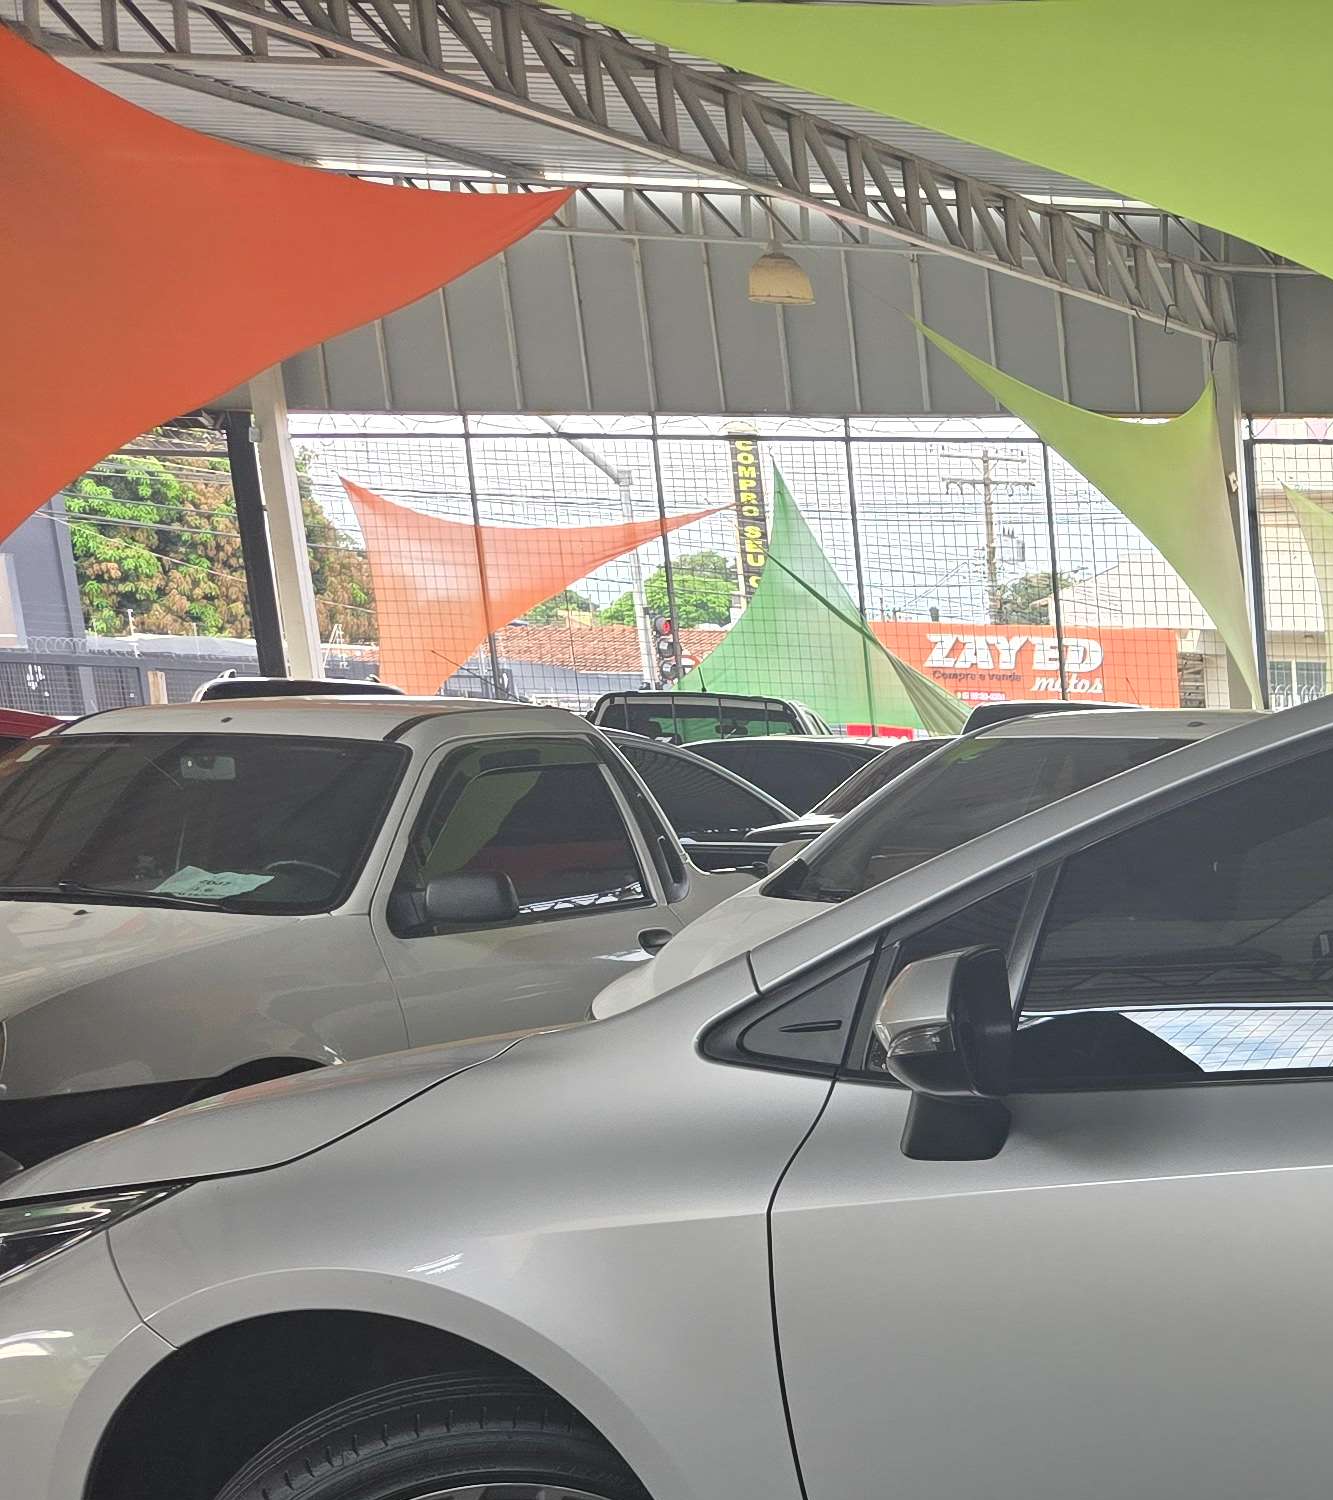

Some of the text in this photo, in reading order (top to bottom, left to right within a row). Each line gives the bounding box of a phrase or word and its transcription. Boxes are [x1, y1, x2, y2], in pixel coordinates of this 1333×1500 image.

[734, 439, 760, 518] COMPRO
[743, 525, 765, 567] SEU
[923, 633, 1105, 673] ZAYED
